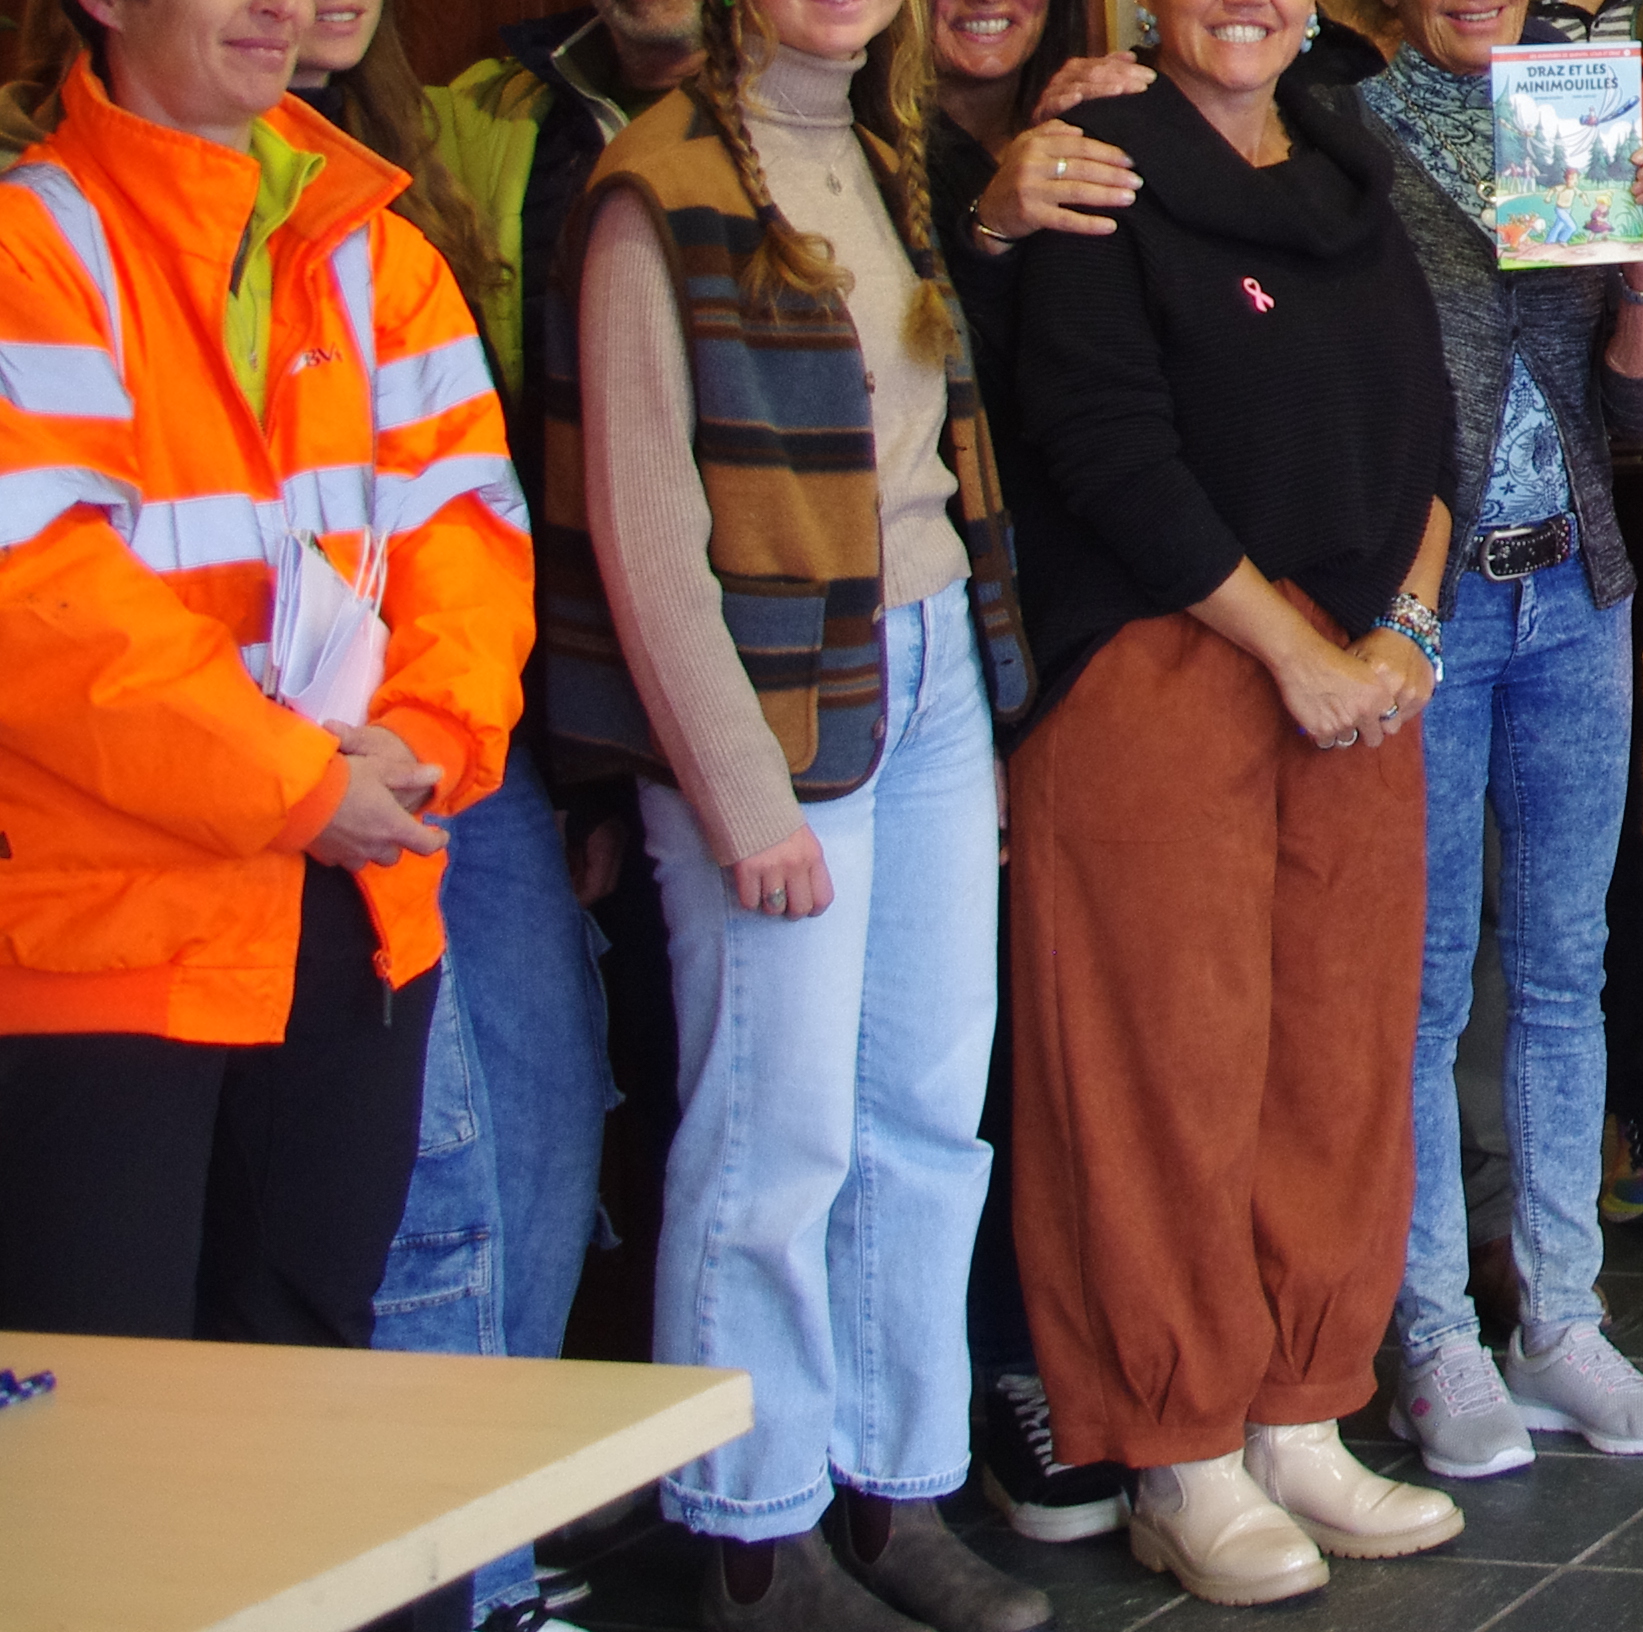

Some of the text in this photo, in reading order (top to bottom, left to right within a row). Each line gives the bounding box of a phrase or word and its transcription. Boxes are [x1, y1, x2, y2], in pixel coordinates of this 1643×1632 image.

[1526, 63, 1606, 78] DRAZ ET LES
[1515, 77, 1619, 93] MINIMOUILLES
